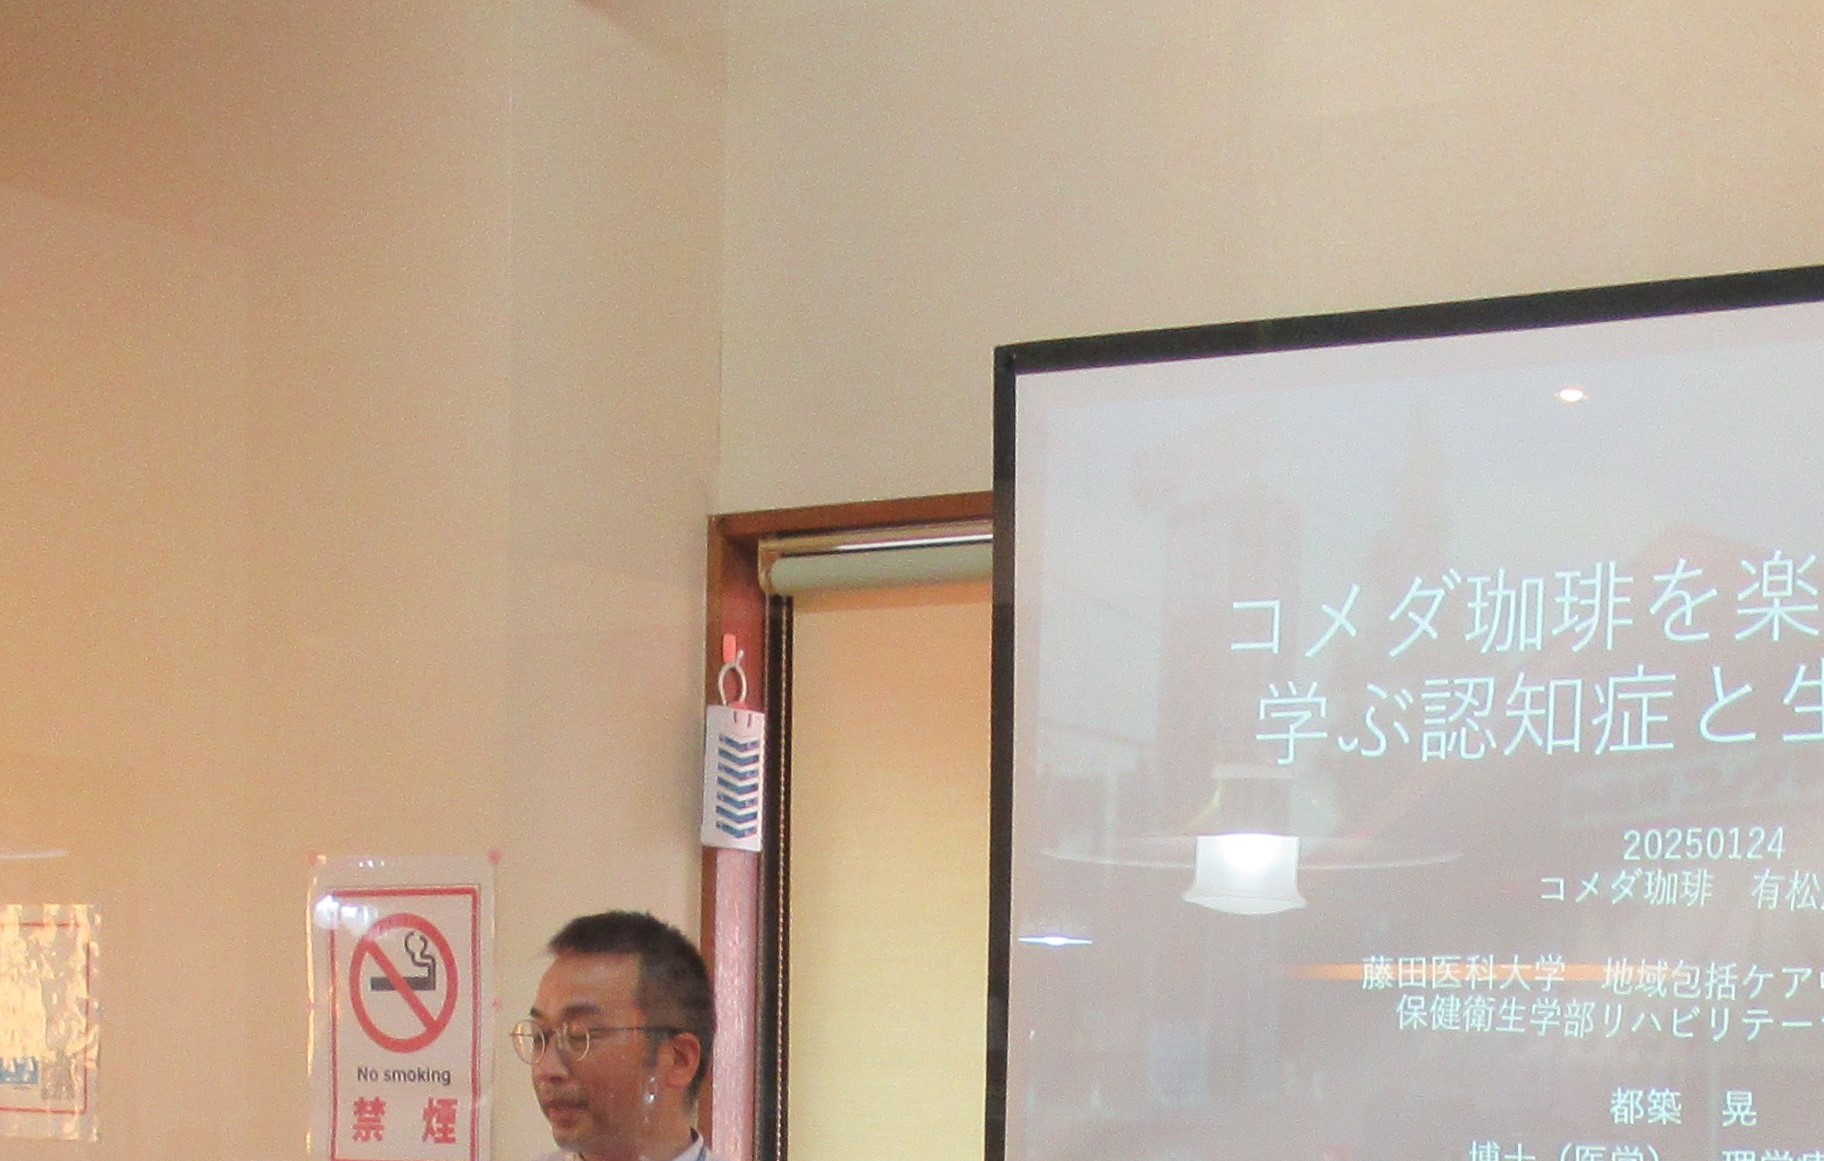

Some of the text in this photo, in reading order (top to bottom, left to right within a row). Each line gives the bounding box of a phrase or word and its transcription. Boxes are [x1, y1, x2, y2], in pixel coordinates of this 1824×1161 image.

[1623, 826, 1786, 861] 20250124
[1541, 867, 1714, 907] コメダ珈琲
[1361, 953, 1567, 993] 藤田医科大学
[357, 1067, 451, 1086] No smoking
[352, 1096, 459, 1144] 禁煙
[1610, 1087, 1758, 1127] 都築 晃
